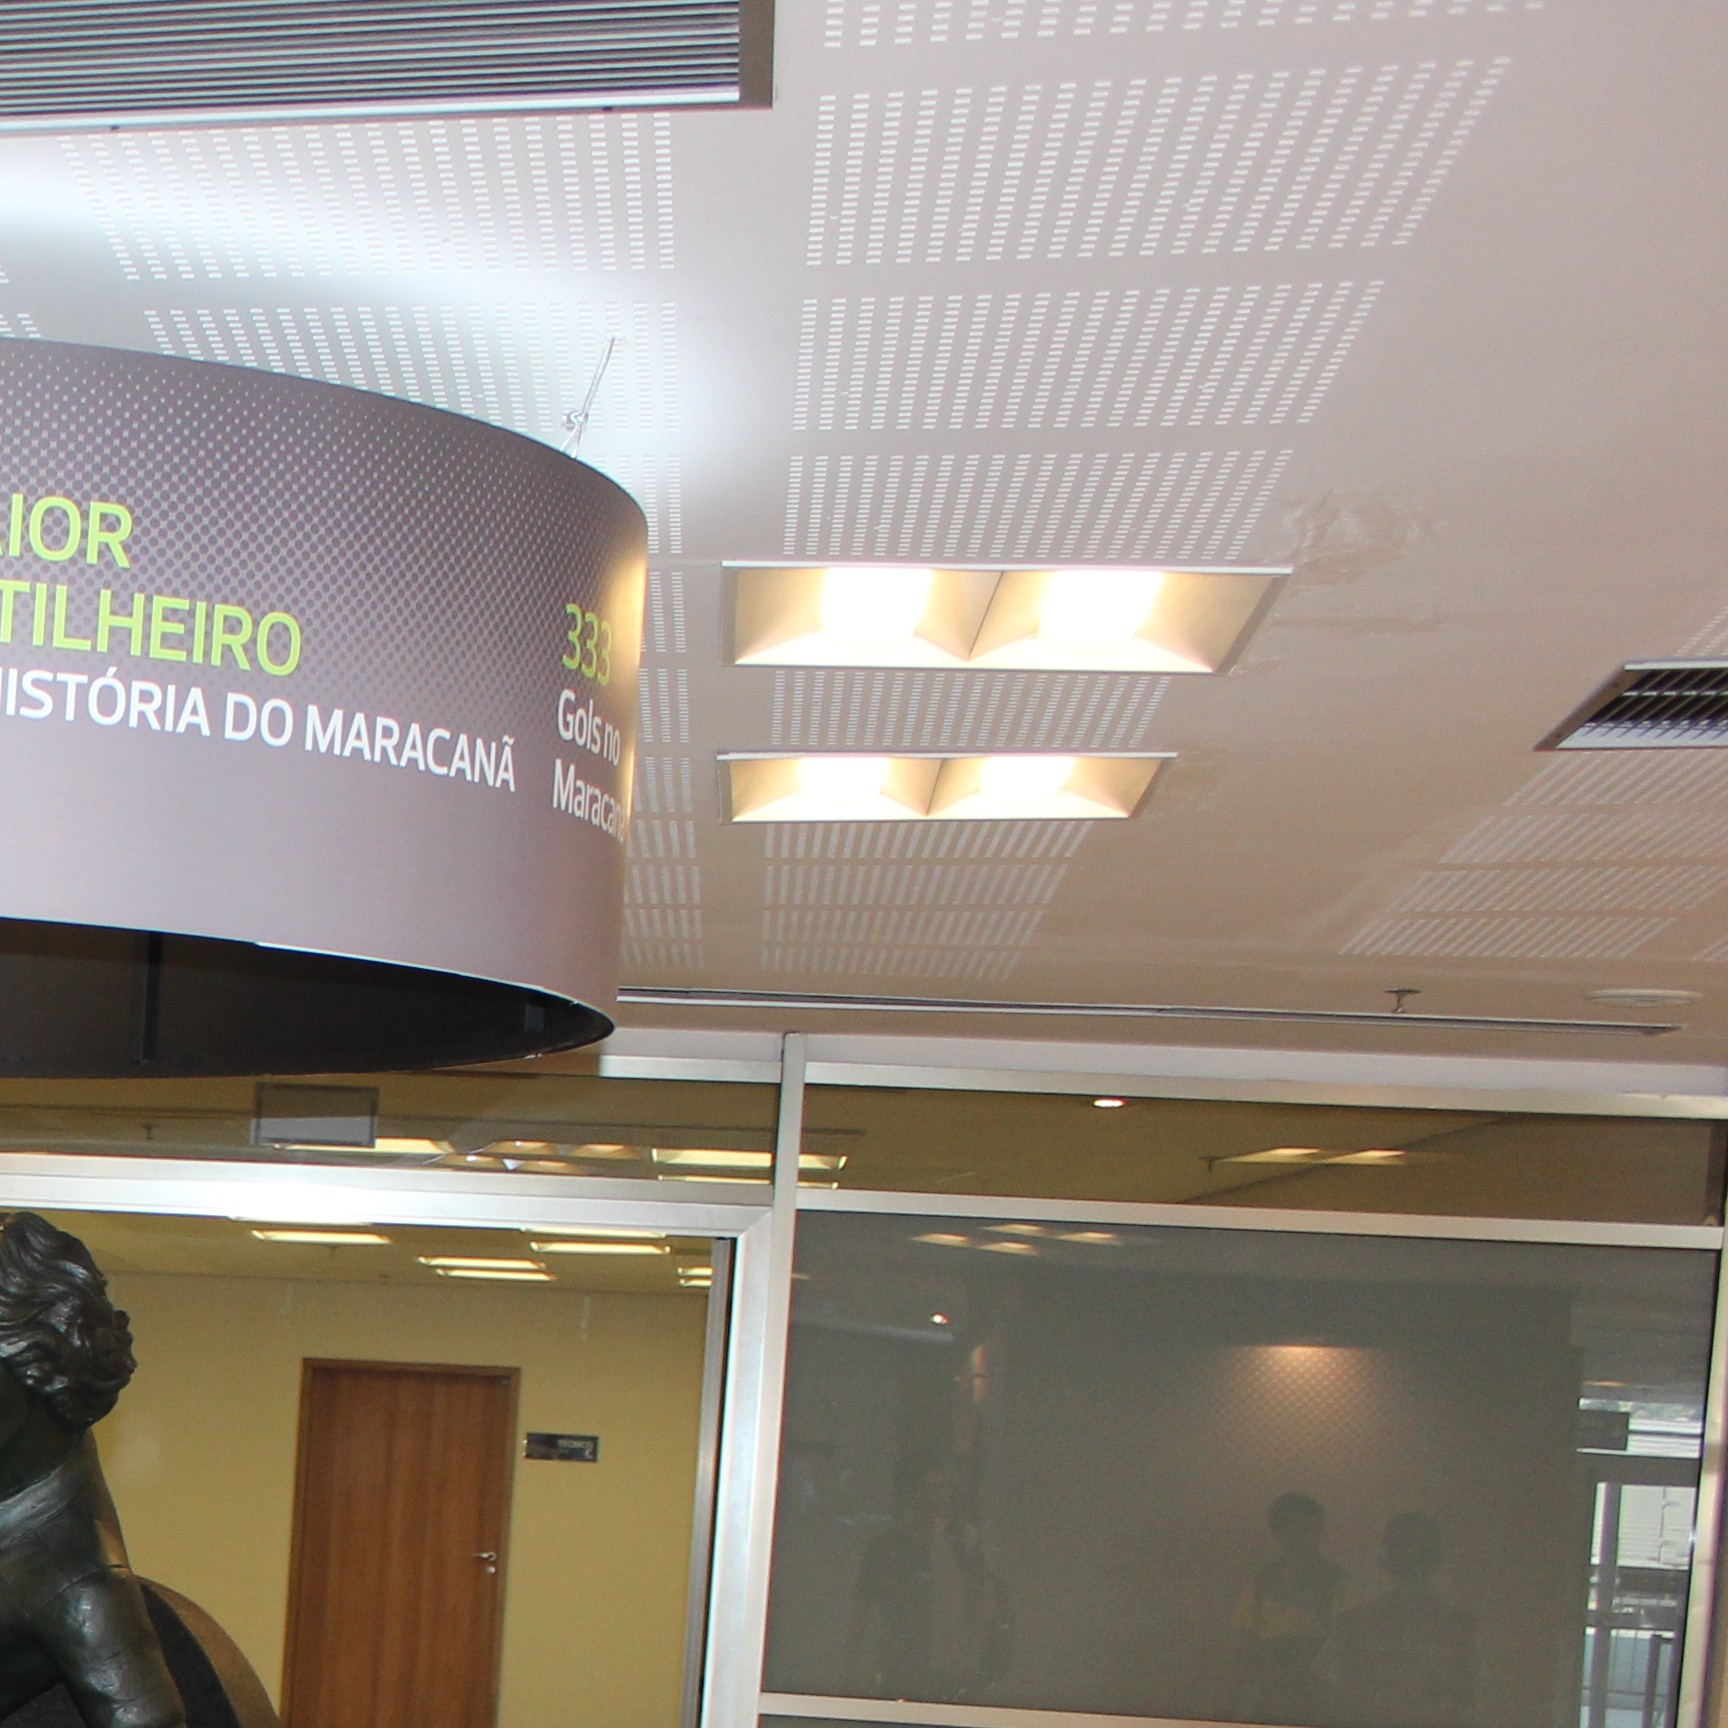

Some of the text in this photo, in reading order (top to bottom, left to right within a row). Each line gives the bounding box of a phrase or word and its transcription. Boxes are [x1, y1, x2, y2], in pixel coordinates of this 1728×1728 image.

[562, 602, 613, 687] 333
[224, 691, 295, 748] DO
[304, 702, 519, 793] MARACANÃ
[557, 688, 621, 767] Gols no
